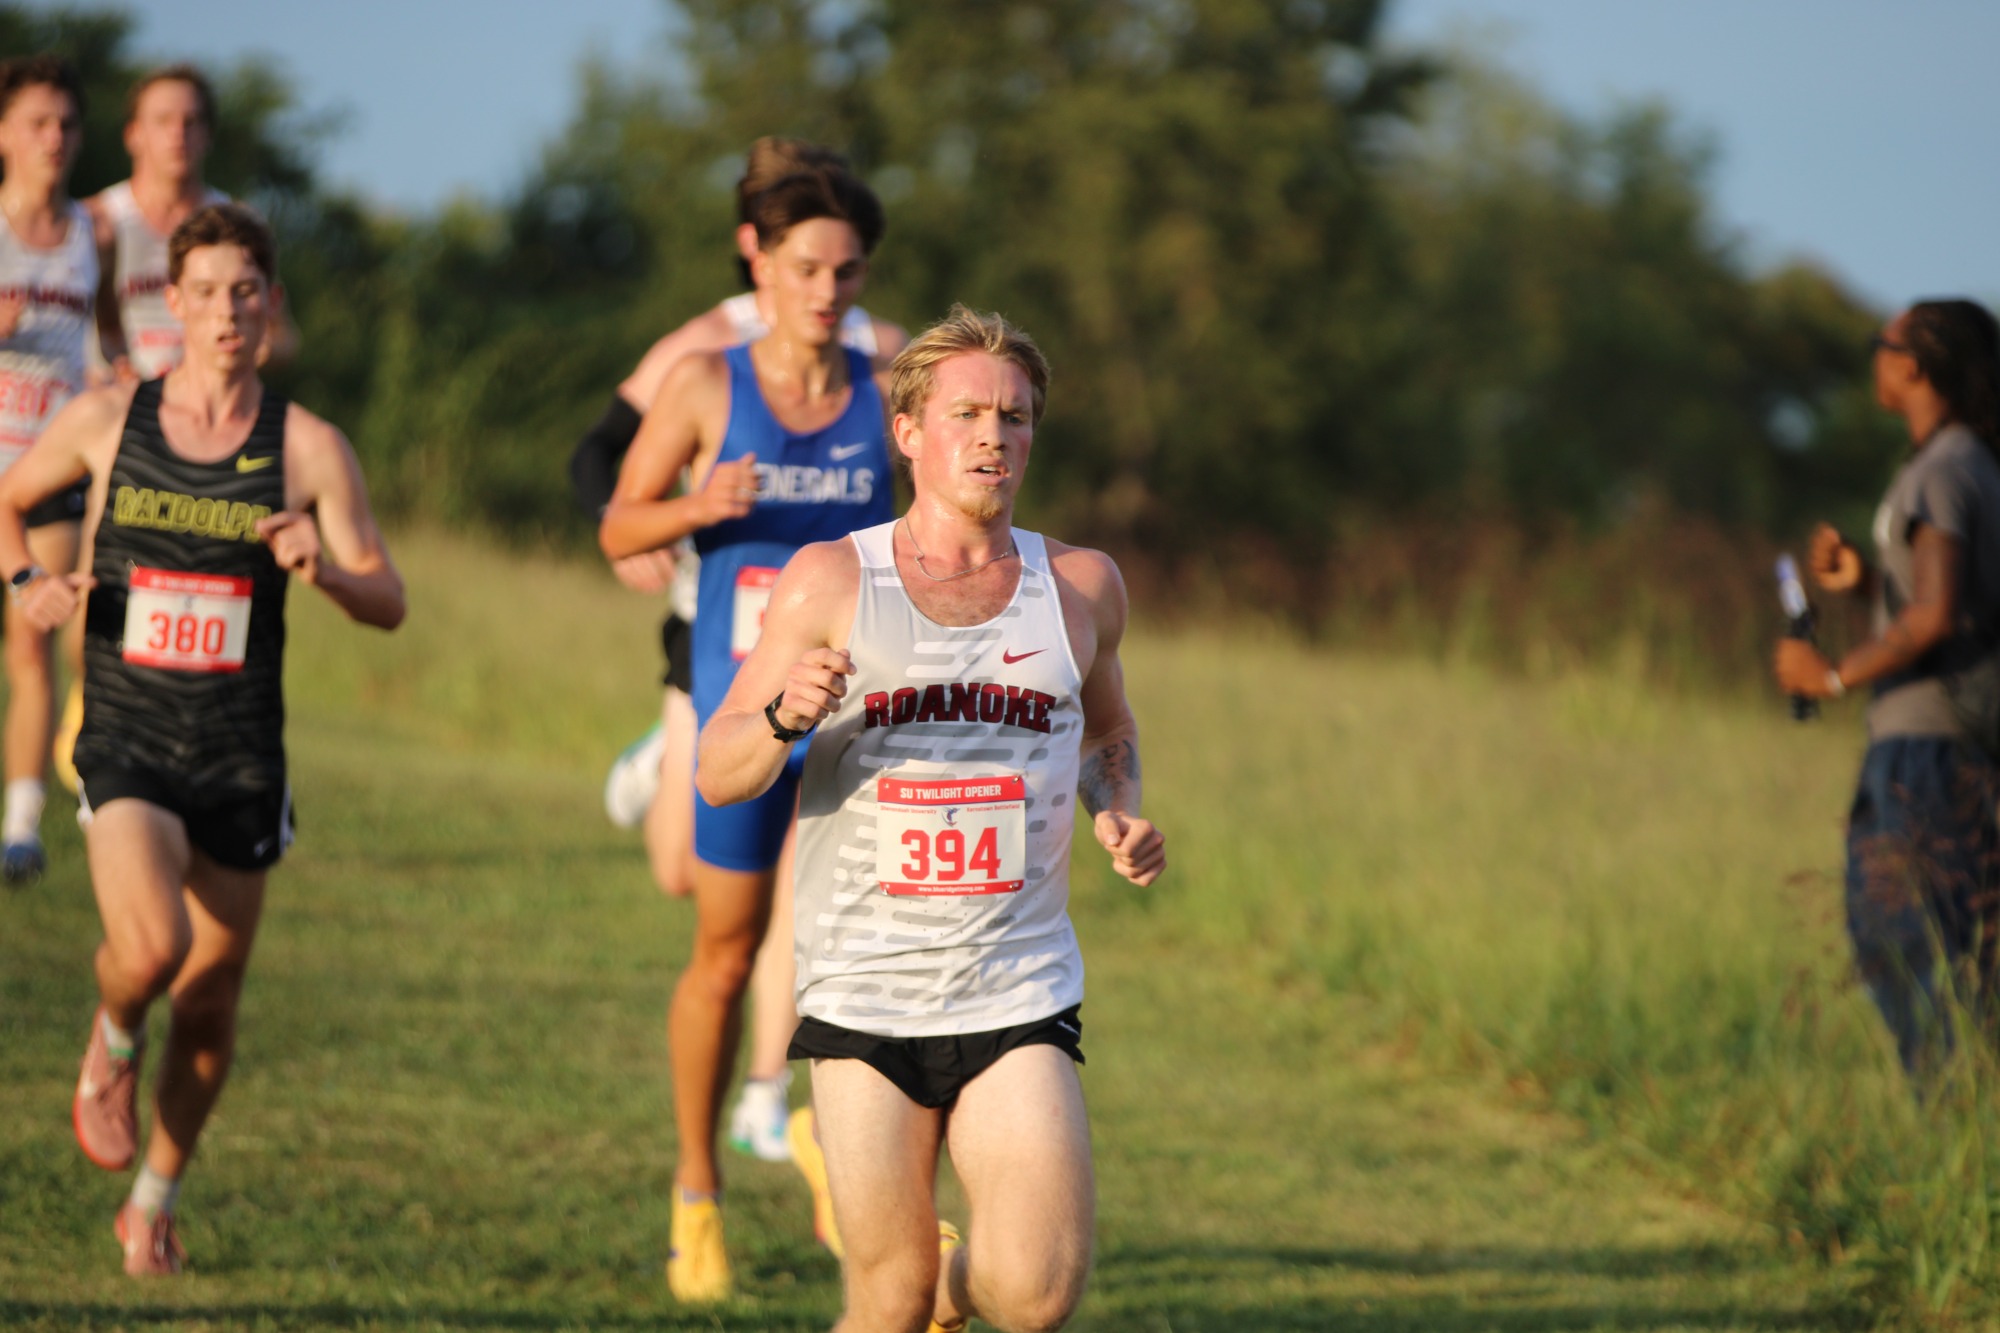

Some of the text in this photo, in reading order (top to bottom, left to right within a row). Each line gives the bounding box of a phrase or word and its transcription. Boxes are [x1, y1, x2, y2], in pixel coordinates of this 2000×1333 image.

[755, 462, 874, 504] ENERALS
[149, 612, 226, 656] 380
[864, 682, 1057, 734] ROANOKE
[900, 784, 1002, 800] SU TWILIGHT OPENER
[901, 826, 1002, 881] 394
